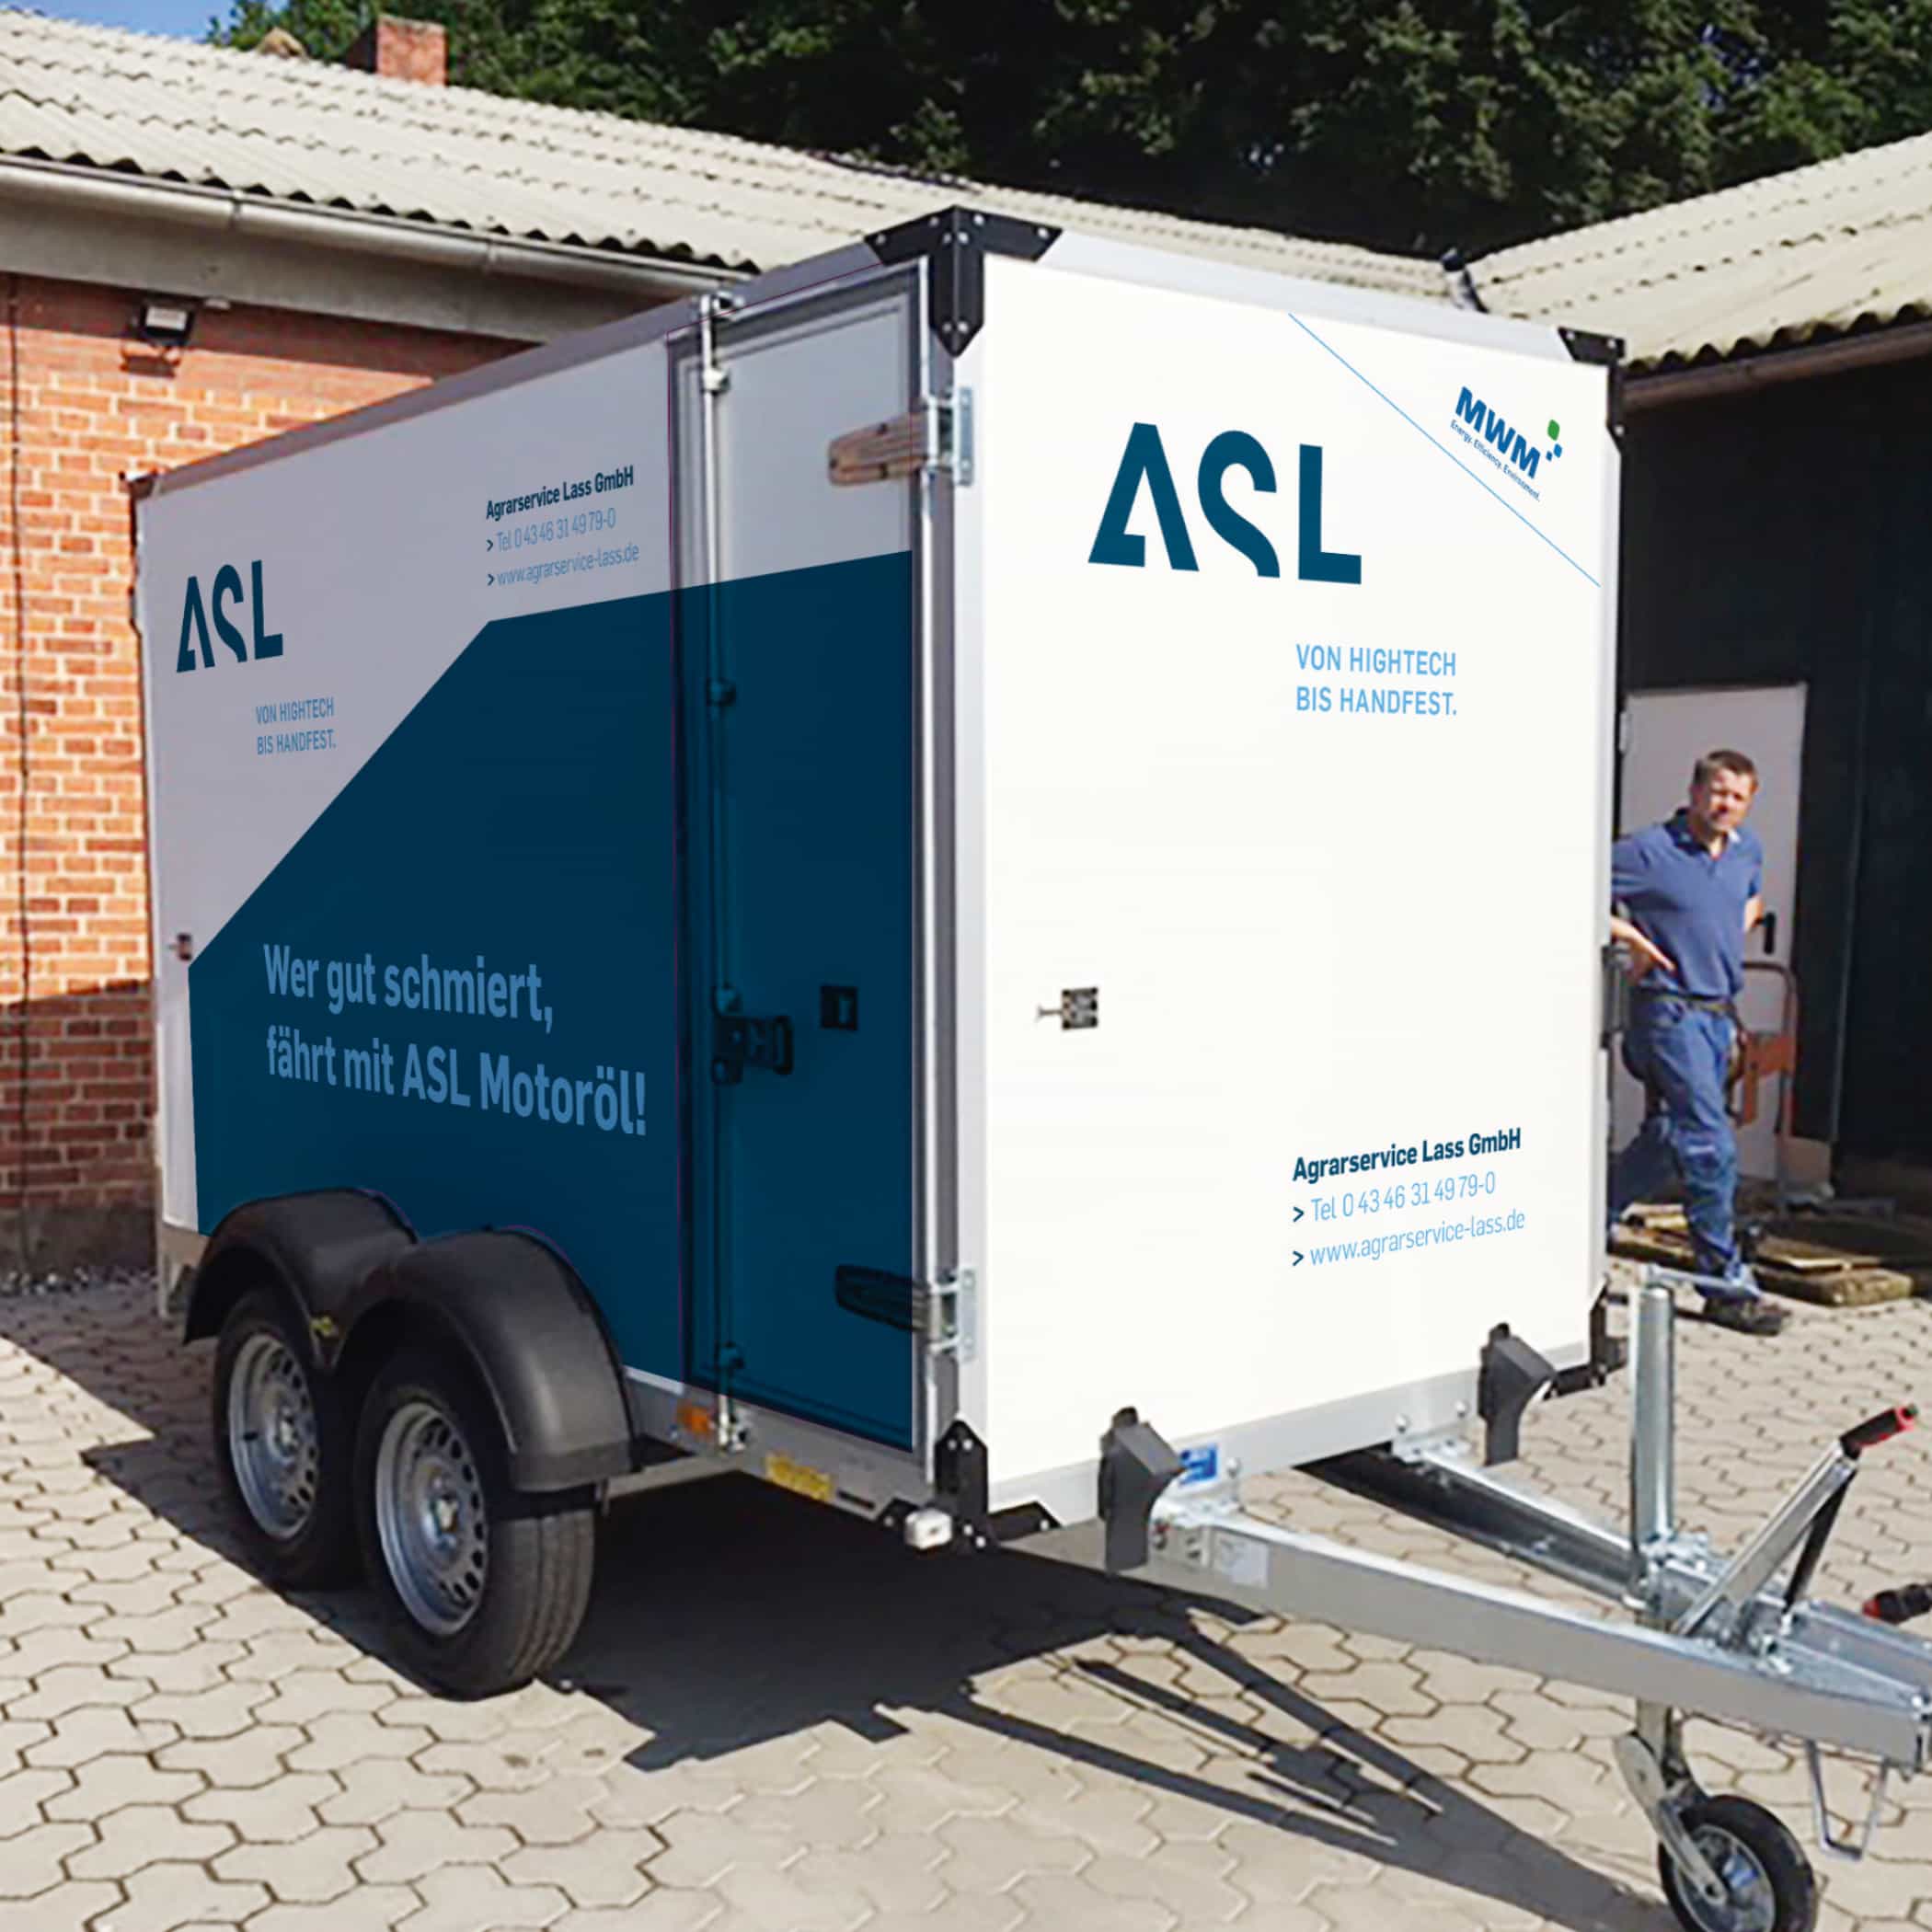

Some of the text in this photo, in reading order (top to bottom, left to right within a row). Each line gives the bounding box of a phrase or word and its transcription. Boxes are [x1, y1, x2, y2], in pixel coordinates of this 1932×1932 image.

[1455, 385, 1541, 479] MWM
[486, 465, 635, 522] Agrarservice Lass GmbH
[1087, 421, 1362, 585] ASL
[497, 541, 640, 585] www.agrarservice-lass.de
[498, 528, 512, 553] Tel
[176, 559, 283, 673] ASL
[1295, 644, 1457, 676] VON HIGHTECH
[256, 696, 335, 724] VON HIGHTECH
[1295, 685, 1458, 716] BIS HANDFEST.
[257, 728, 337, 755] BIS HANDFEST.
[263, 943, 553, 1035] Wer gut schmiert,
[266, 1024, 647, 1137] fährt mit ASL Motoröl!
[1292, 1127, 1522, 1185] Agrarservice Lass GmbH
[1311, 1196, 1338, 1222] Tel
[1342, 1192, 1354, 1217] 0
[1310, 1208, 1526, 1266] www.agrarservice-lass.de
